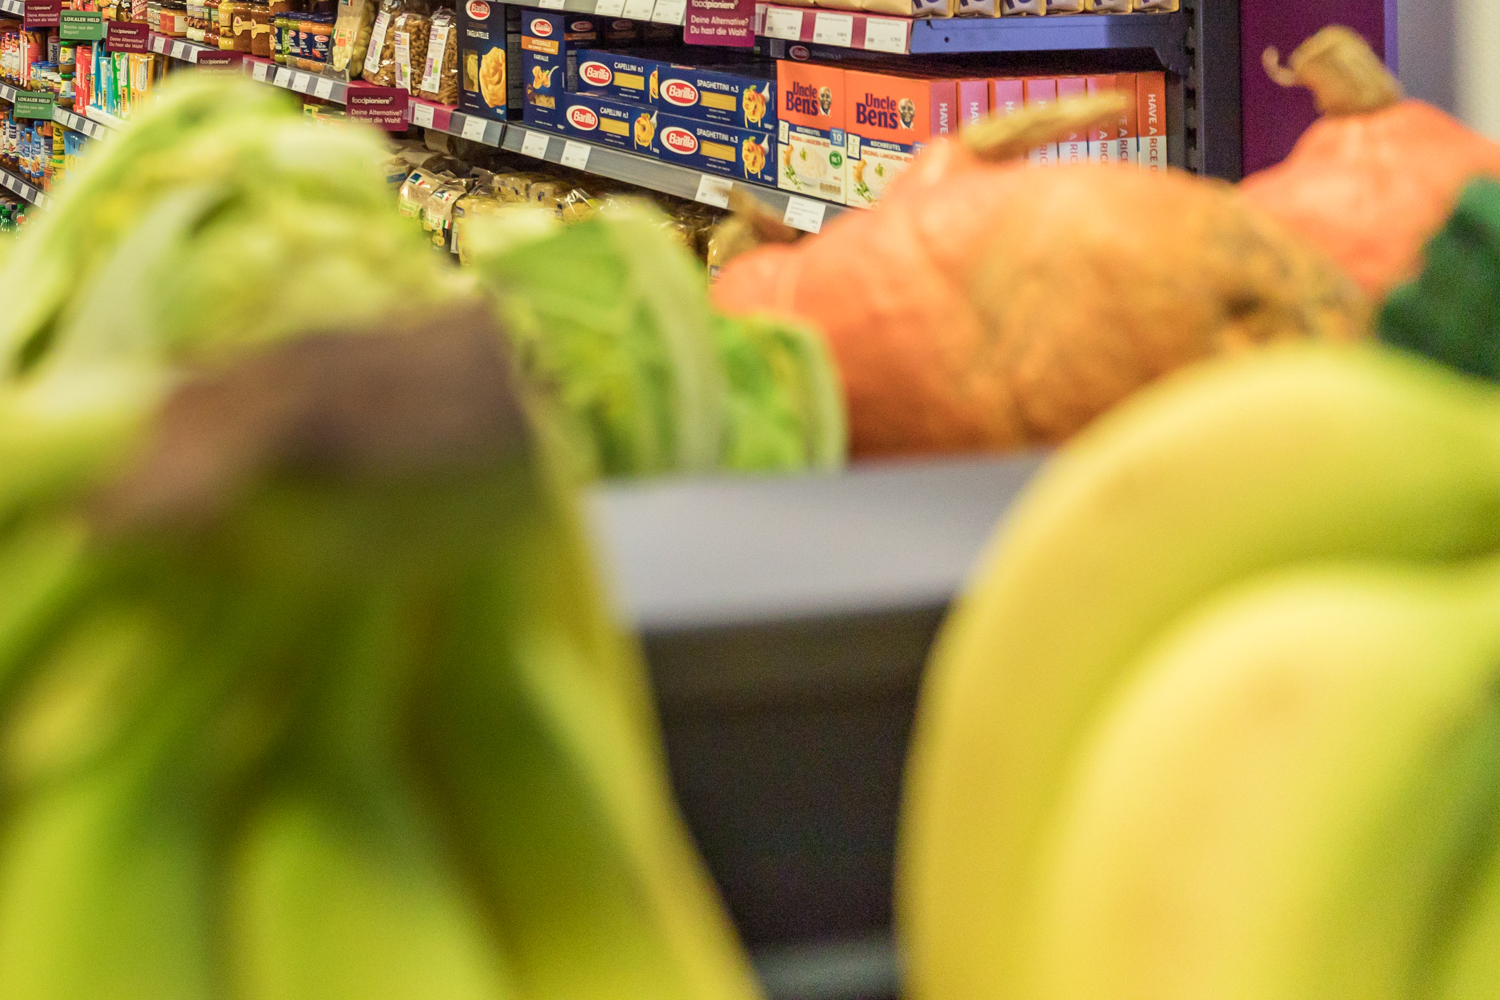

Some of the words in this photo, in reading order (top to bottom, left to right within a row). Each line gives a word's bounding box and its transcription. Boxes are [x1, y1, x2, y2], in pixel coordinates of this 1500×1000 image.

[691, 15, 709, 24] Deine
[711, 16, 748, 26] Alternative?
[690, 26, 700, 34] Du
[701, 26, 715, 35] hast
[717, 27, 726, 35] die
[728, 28, 747, 37] Wahl!
[587, 66, 609, 81] Barilla
[614, 62, 636, 72] CAPELLINI
[668, 85, 695, 101] Barilla
[696, 80, 729, 92] SPAGHETTINI
[793, 81, 817, 98] Uncle
[865, 93, 896, 111] Uncle
[573, 111, 596, 128] Barilla
[600, 107, 622, 118] CAPELLINI
[939, 103, 948, 134] HAVE
[1148, 94, 1158, 130] HAVE
[696, 128, 729, 142] SPAGHETTINI
[833, 133, 842, 142] 10
[1149, 127, 1157, 136] A
[668, 133, 695, 149] Barilla
[1149, 138, 1158, 163] RICE
